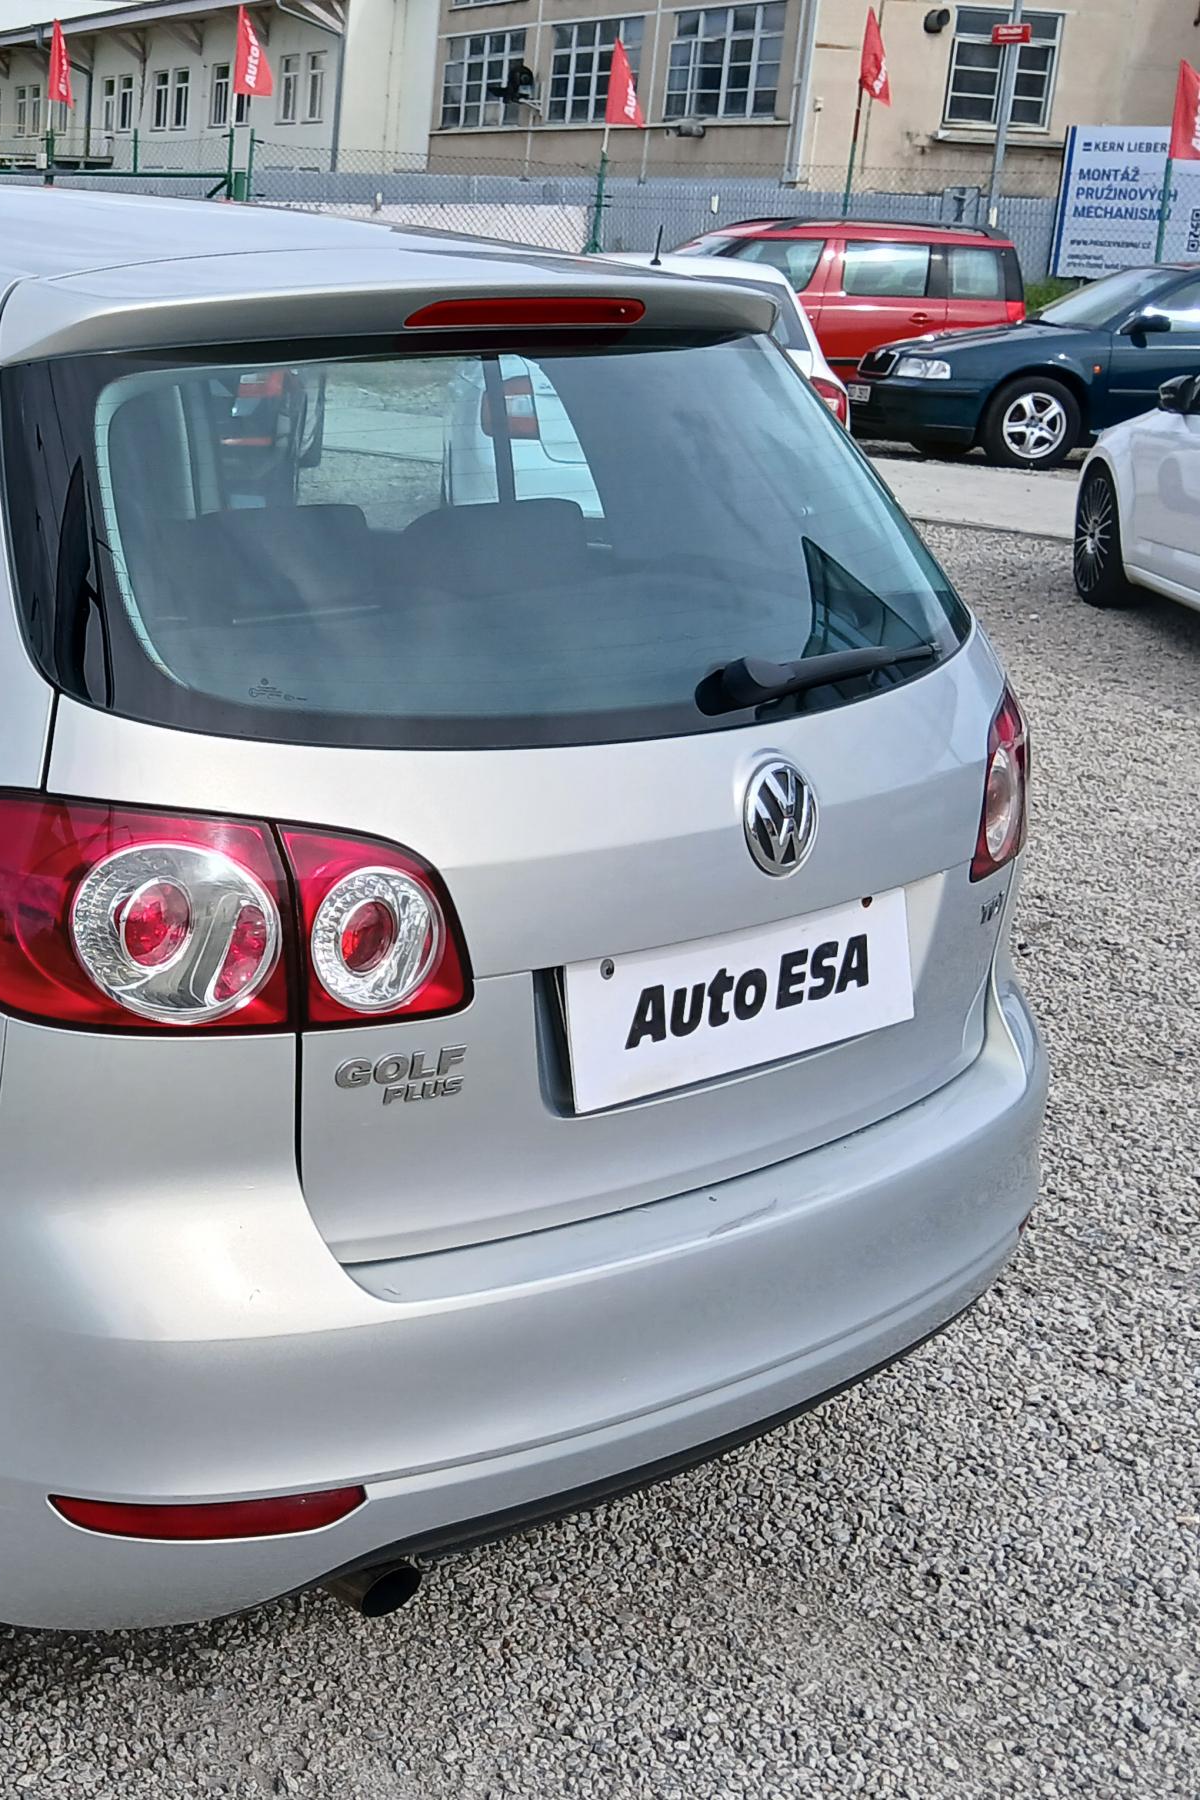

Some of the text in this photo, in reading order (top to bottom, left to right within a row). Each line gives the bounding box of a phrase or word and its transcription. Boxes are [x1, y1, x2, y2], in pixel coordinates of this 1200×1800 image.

[245, 45, 260, 88] Auto
[1094, 141, 1168, 153] KERN LIEBER
[1078, 166, 1140, 182] MONTÁŽ
[1076, 184, 1178, 202] PRUŽINOVÝCH
[625, 933, 869, 1050] Auto ESA
[335, 1043, 467, 1089] GOLF
[382, 1075, 465, 1105] PLUS
